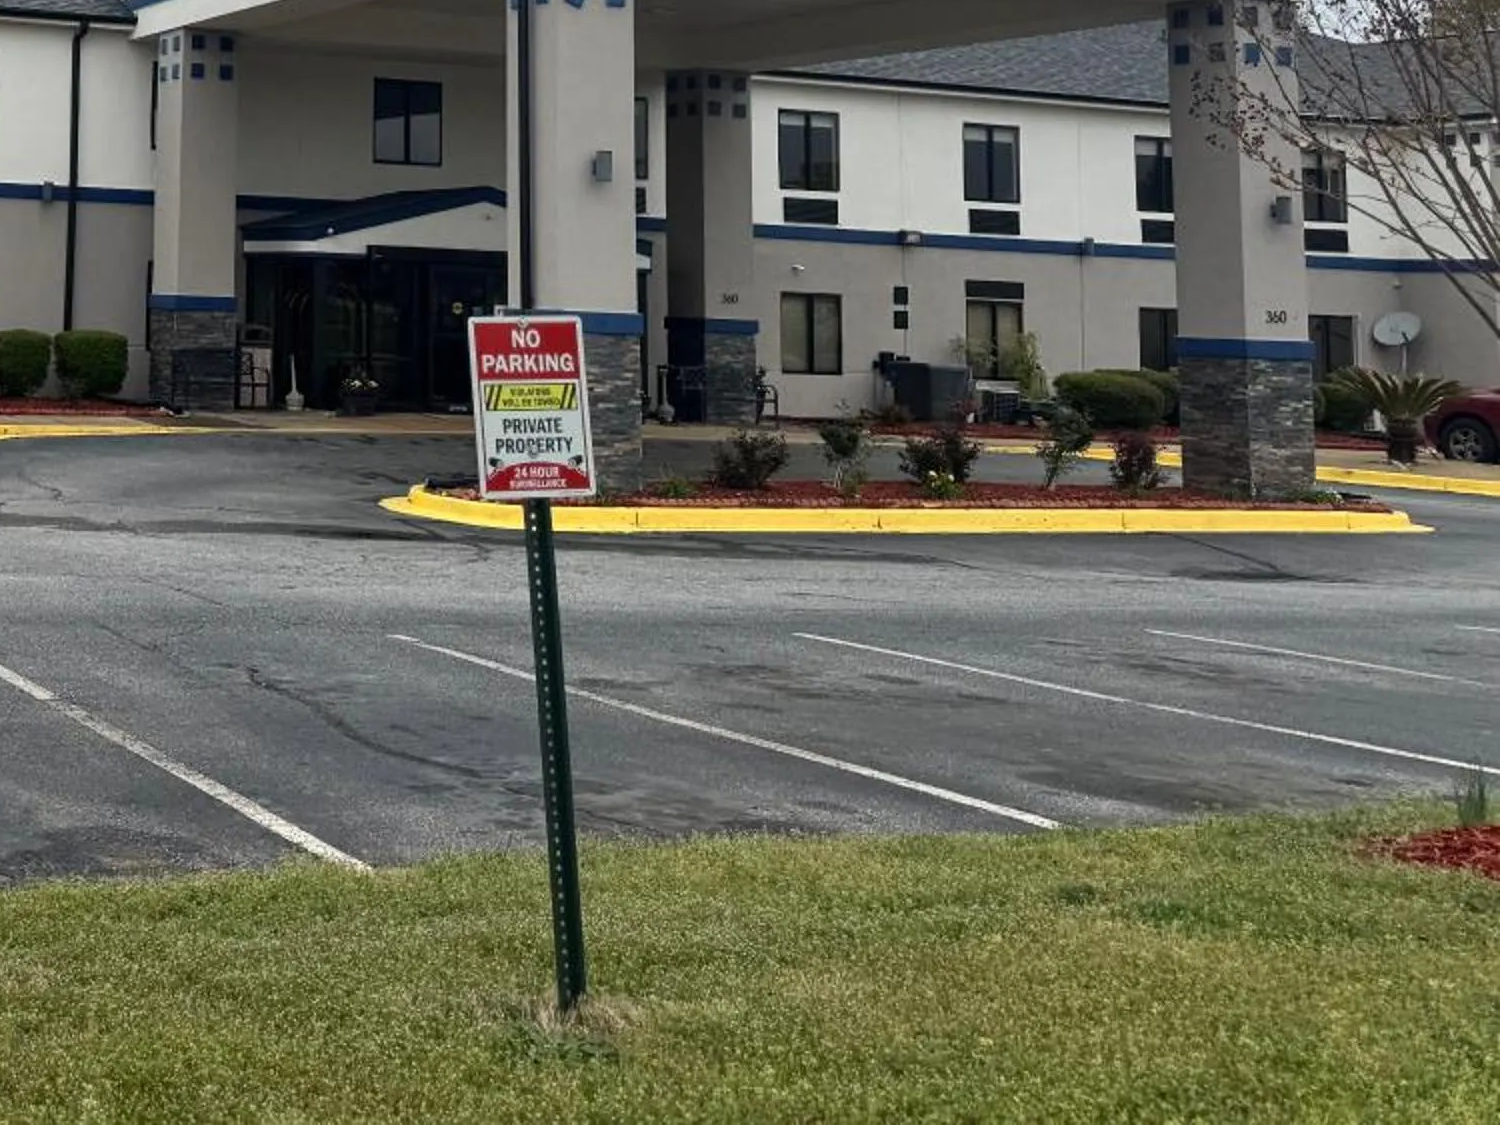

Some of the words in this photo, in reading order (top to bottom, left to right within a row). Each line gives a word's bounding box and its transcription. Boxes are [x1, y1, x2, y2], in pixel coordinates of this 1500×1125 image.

[1266, 310, 1286, 324] 360
[511, 329, 541, 348] NO
[482, 353, 575, 373] PARKING
[502, 417, 563, 434] PRIVATE
[495, 436, 573, 453] PROPERTY
[514, 466, 529, 478] 24
[530, 466, 560, 478] HOUR
